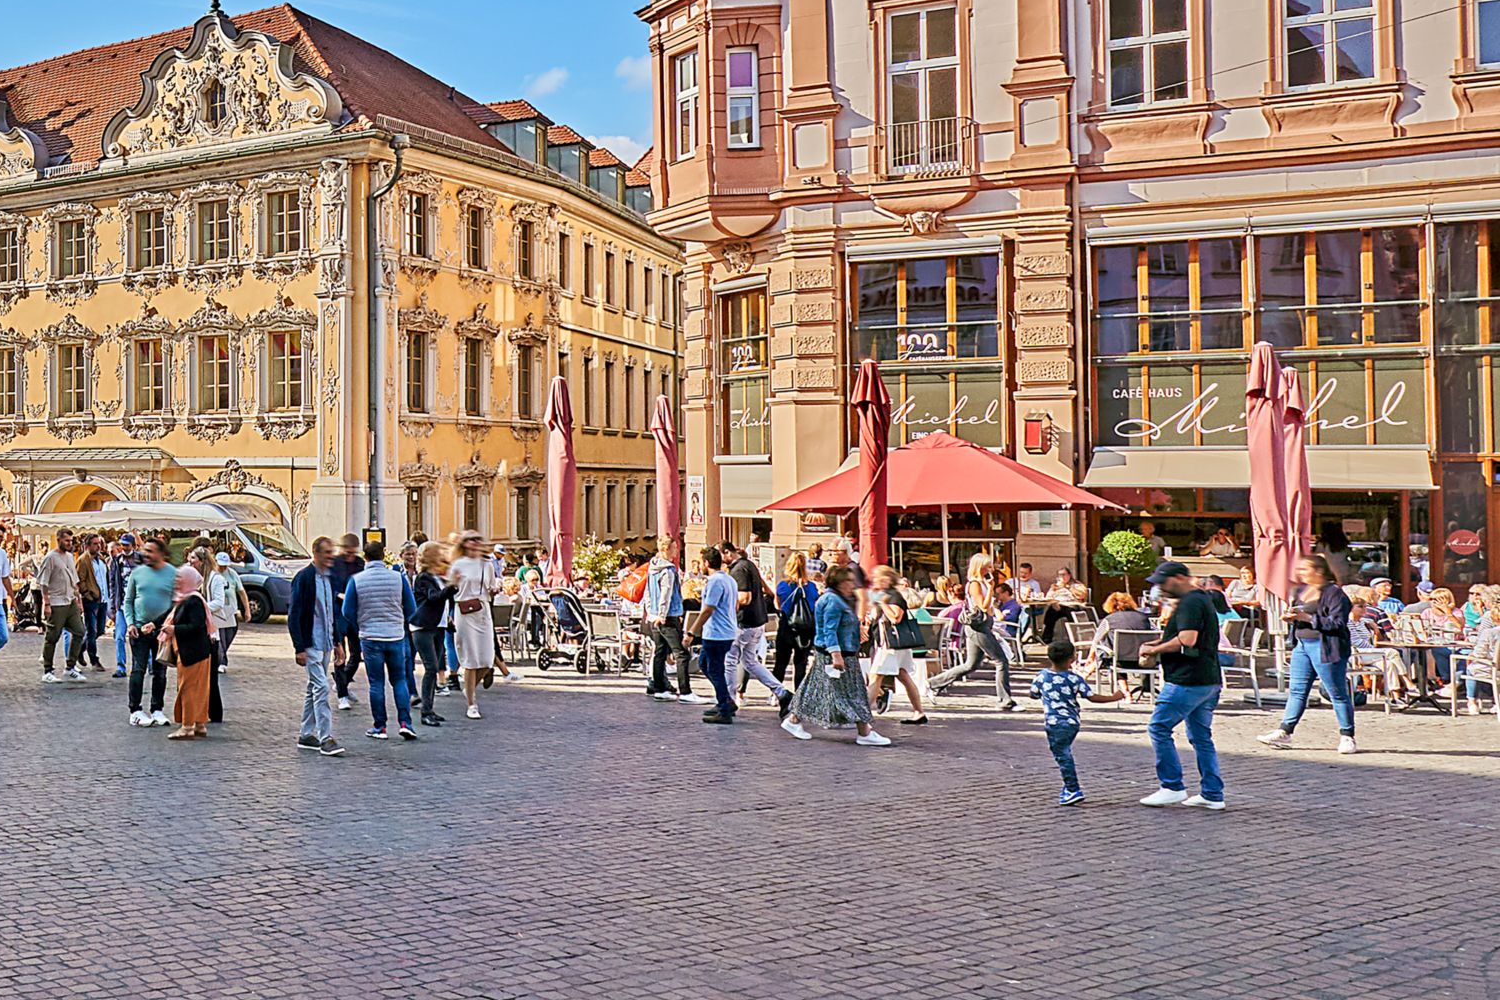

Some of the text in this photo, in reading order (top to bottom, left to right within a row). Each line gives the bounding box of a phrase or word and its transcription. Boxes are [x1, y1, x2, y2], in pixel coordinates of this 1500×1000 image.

[896, 334, 938, 348] 100
[1112, 386, 1182, 398] CAFÉ HAUS
[1113, 377, 1408, 439] Mihel
